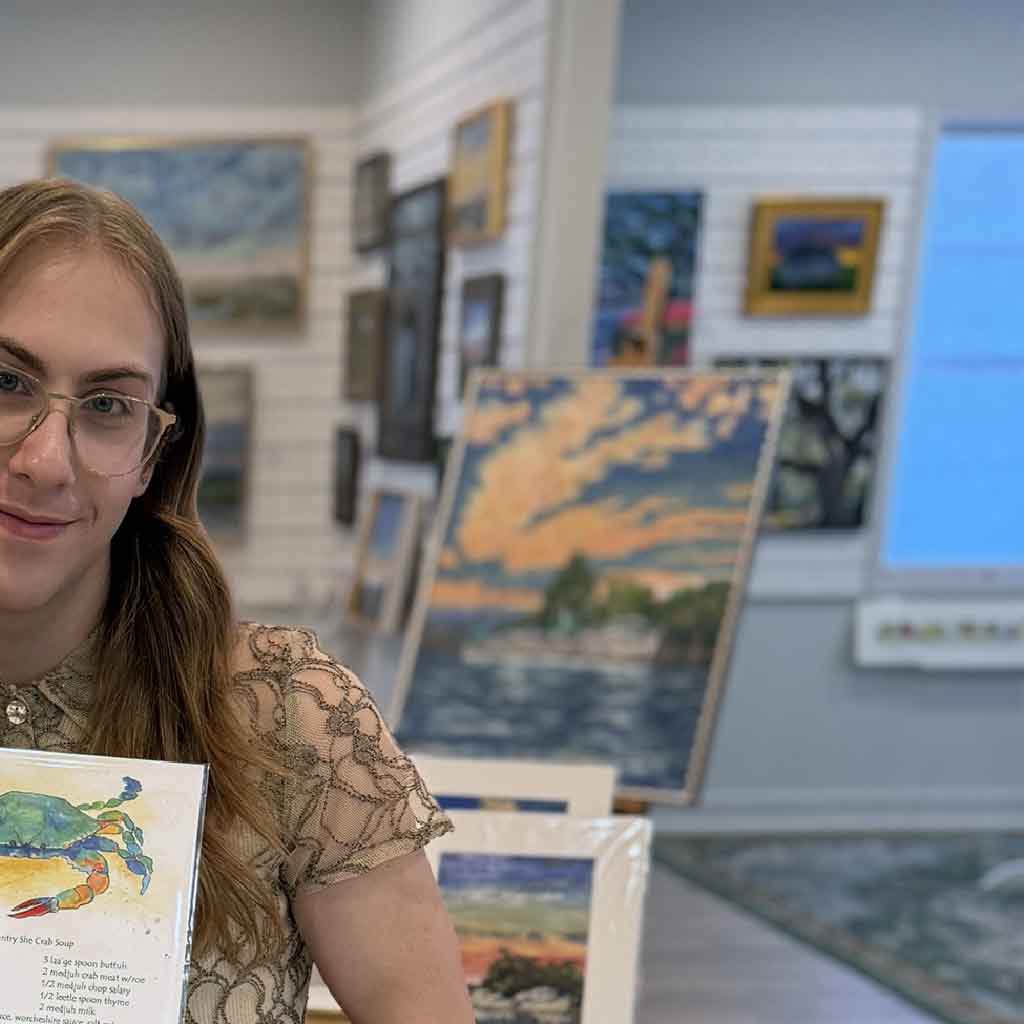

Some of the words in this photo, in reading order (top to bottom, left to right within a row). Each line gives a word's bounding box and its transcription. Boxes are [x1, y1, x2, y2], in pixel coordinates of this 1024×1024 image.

[19, 935, 33, 943] She
[34, 937, 52, 945] Crab
[55, 939, 74, 949] Soup
[73, 960, 98, 969] spoon
[81, 970, 98, 979] crab
[99, 971, 120, 981] meat
[41, 979, 55, 988] 1/2
[87, 983, 107, 994] chop
[108, 984, 131, 996] salary
[39, 991, 54, 1000] 1/2
[78, 996, 102, 1006] spoon
[103, 996, 130, 1008] thyme
